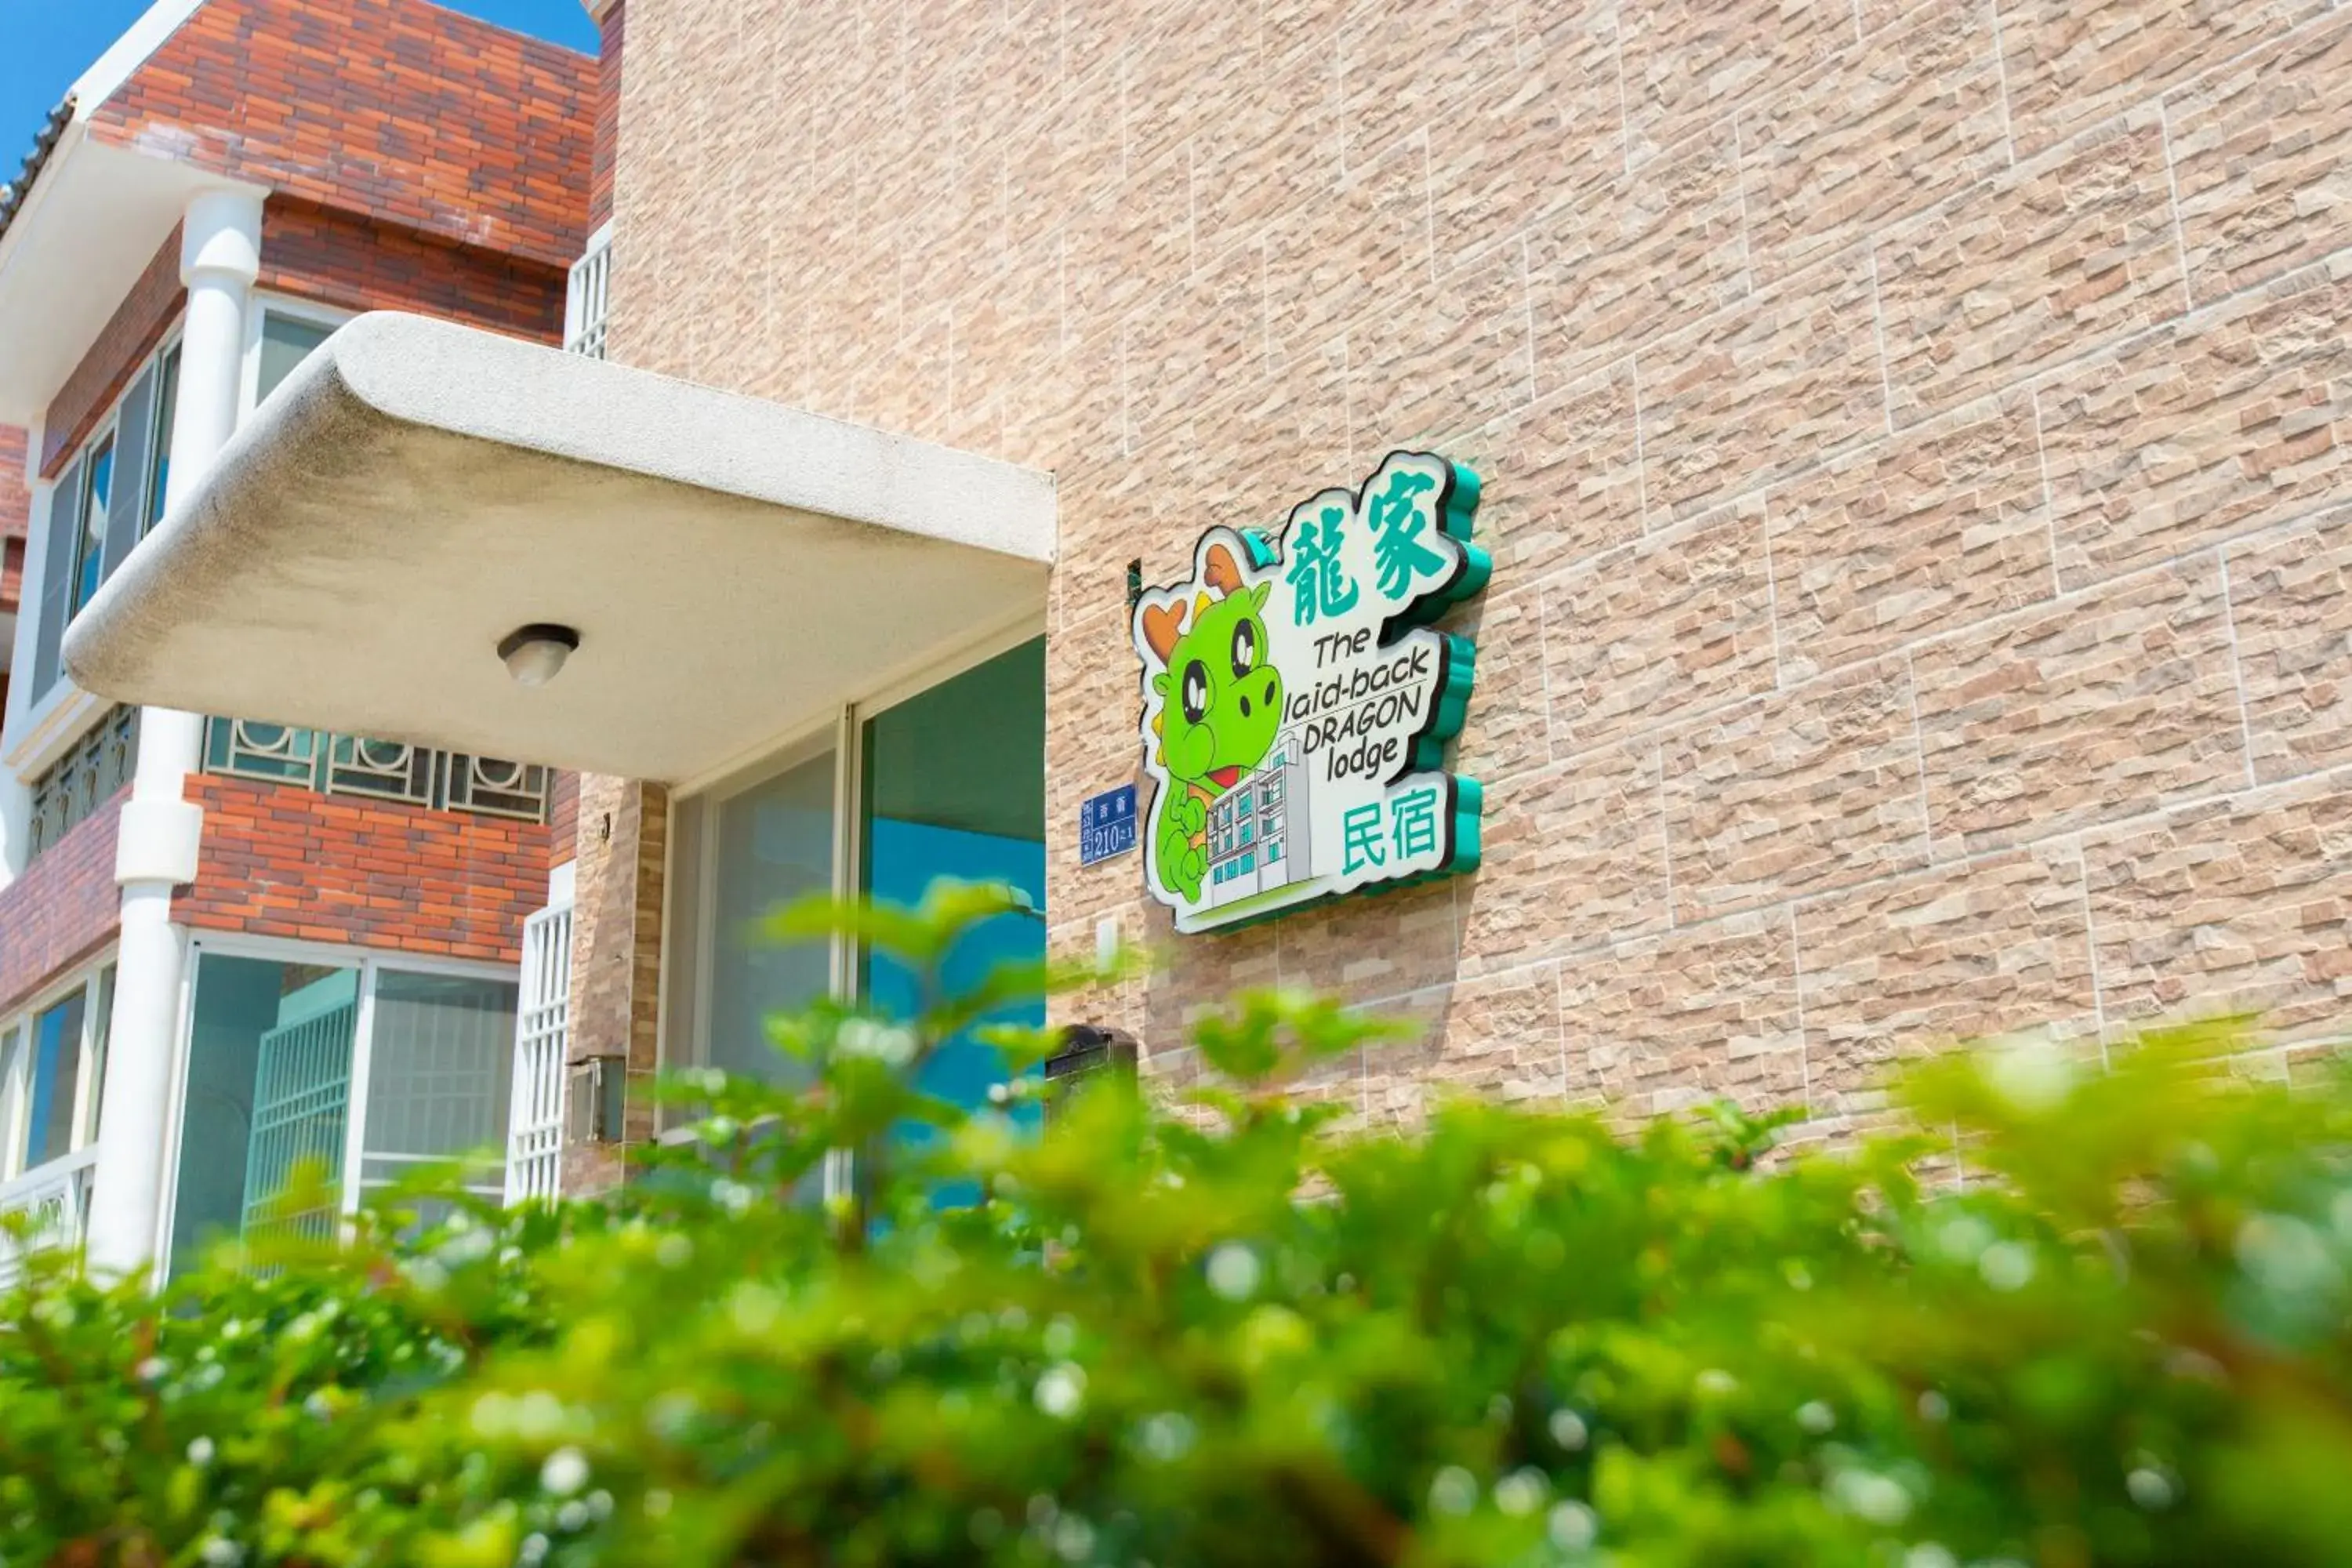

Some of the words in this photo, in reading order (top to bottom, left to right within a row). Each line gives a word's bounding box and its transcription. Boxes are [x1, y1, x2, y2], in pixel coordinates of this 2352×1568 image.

[1285, 470, 1446, 627] 龍家
[1283, 646, 1431, 724] laid-back
[1314, 627, 1371, 669] The
[1303, 684, 1421, 755] DRAGON
[1327, 735, 1398, 782] lodge
[1341, 788, 1437, 876] 民宿
